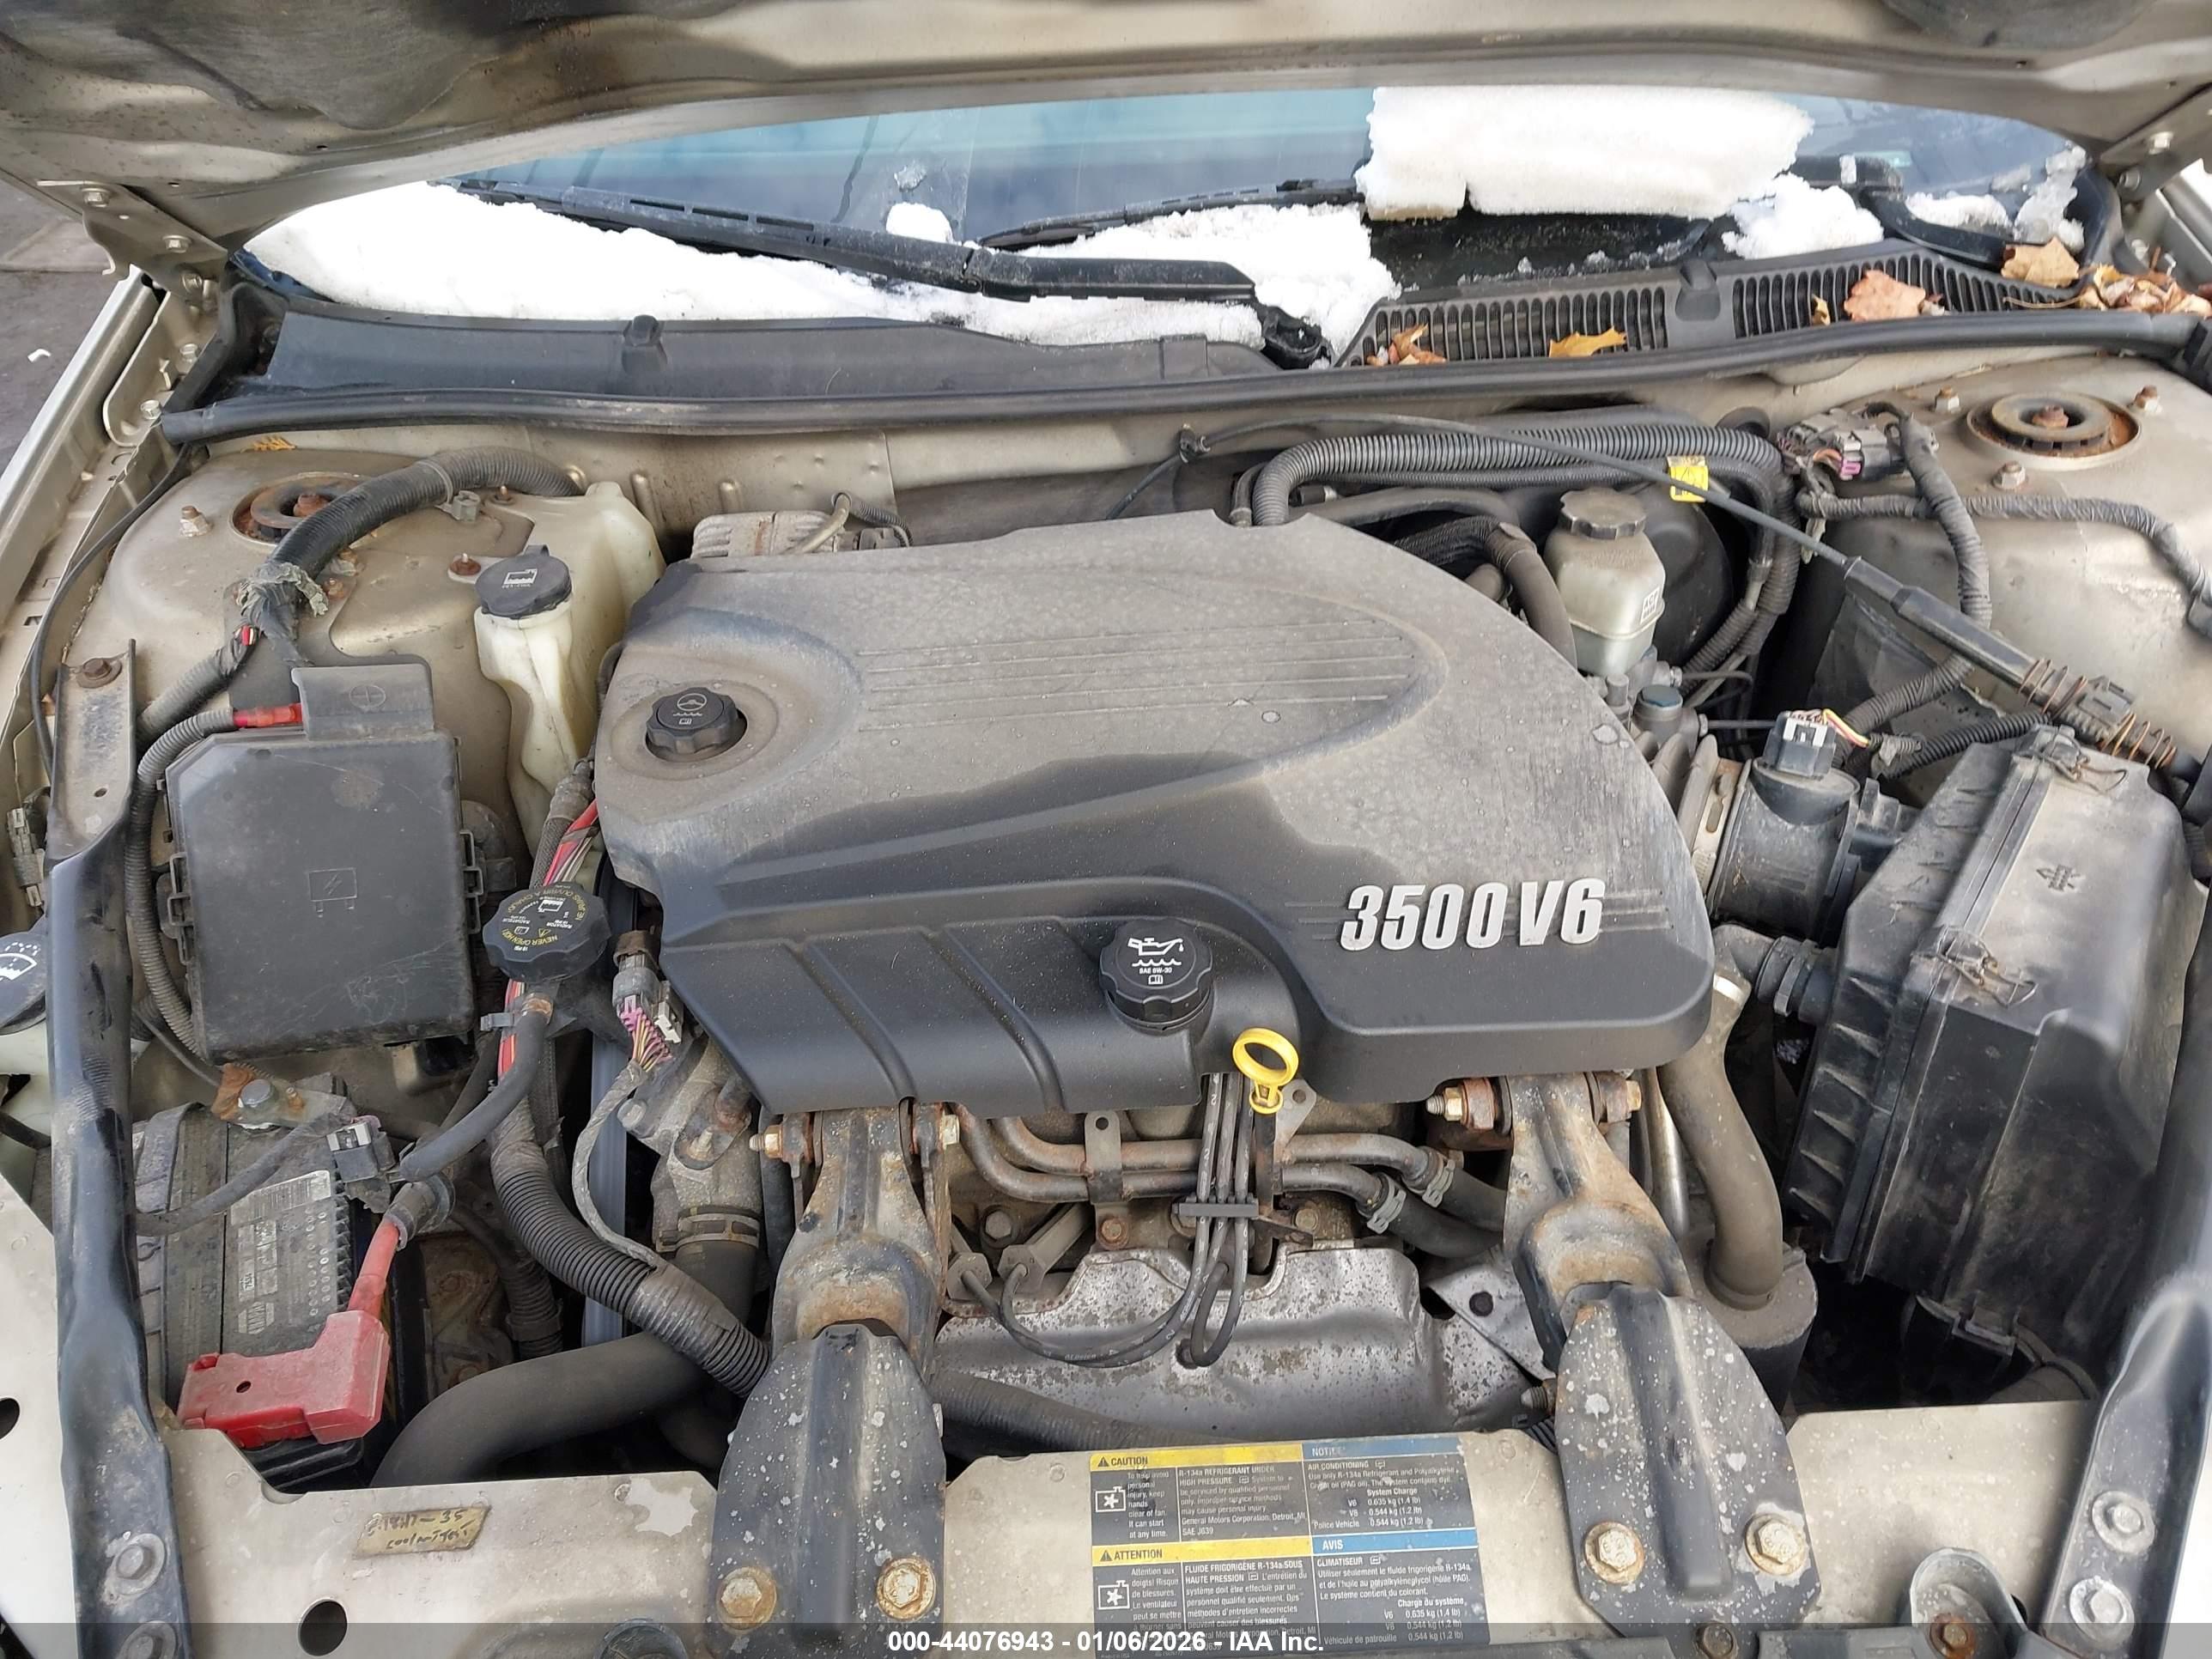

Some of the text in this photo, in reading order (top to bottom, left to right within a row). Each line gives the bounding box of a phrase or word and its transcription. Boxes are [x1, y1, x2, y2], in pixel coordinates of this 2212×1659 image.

[1340, 878, 1606, 951] 3500 V6
[513, 936, 531, 945] OPEN
[532, 935, 558, 946] NEVER
[1110, 1456, 1148, 1466] CAUTION
[1321, 1461, 1369, 1470] CONDITIONING
[1204, 1466, 1249, 1476] REFRIGERANT
[1251, 1465, 1274, 1474] UNDER
[1322, 1471, 1335, 1480] only
[1363, 1468, 1399, 1479] Refrigerant
[1180, 1478, 1195, 1486] HIGH
[1198, 1476, 1232, 1486] PRESSURE
[1341, 1480, 1356, 1489] (PAG
[1190, 1486, 1217, 1495] serviced
[1219, 1486, 1227, 1495] by
[1228, 1485, 1255, 1494] qualified
[1393, 1487, 1418, 1496] Charge
[1388, 1497, 1397, 1507] kg
[1218, 1505, 1246, 1515] personal
[1389, 1508, 1398, 1516] kg
[1399, 1507, 1412, 1516] (1.2
[1413, 1506, 1422, 1515] lb)
[1182, 1516, 1206, 1525] General
[1207, 1514, 1231, 1523] Motors
[1314, 1516, 1424, 1529] Police Vehicle 0.544 kg (1.2 lb)
[1151, 1529, 1168, 1538] time.
[1182, 1527, 1213, 1536] SAE J639
[1322, 1539, 1344, 1551] AVIS
[1114, 1548, 1163, 1560] ATTENTION
[1185, 1565, 1209, 1573] FLUIDE
[1257, 1559, 1283, 1570] R-134a
[1284, 1559, 1303, 1568] SOUS
[1316, 1556, 1363, 1567] CLIMATISEUR
[1131, 1567, 1161, 1576] Attention
[1185, 1569, 1308, 1584] HAUTE PRESSION L'entretien du
[1318, 1569, 1341, 1577] Utiliser
[1343, 1567, 1377, 1577] seulement
[1388, 1566, 1407, 1575] fluide
[1156, 1577, 1179, 1587] Risque
[1328, 1580, 1336, 1589] de
[1338, 1578, 1358, 1589] l'huile
[1432, 1575, 1451, 1585] (huile
[1132, 1589, 1141, 1598] de
[1215, 1584, 1229, 1594] doit
[1230, 1583, 1243, 1593] être
[1274, 1583, 1286, 1591] par
[1330, 1590, 1358, 1600] système
[1359, 1589, 1387, 1598] contient
[1389, 1588, 1398, 1596] du
[1399, 1587, 1428, 1596] colorant.
[1133, 1600, 1177, 1609] Le ventilateur
[1187, 1593, 1300, 1607] personnel qualifié seulement. Des
[1398, 1599, 1423, 1608] Charge
[1425, 1597, 1433, 1606] du
[1133, 1612, 1150, 1621] peut
[1159, 1611, 1182, 1620] mettre
[1187, 1604, 1298, 1618] méthodes d'entretien incorrectes
[1384, 1607, 1461, 1620] V6 kg lb)
[1188, 1620, 1215, 1629] peuvent
[1241, 1618, 1254, 1626] des
[1385, 1621, 1395, 1631] V8
[1427, 1620, 1437, 1630] kg
[1452, 1619, 1462, 1628] lb)
[1308, 1626, 1316, 1635] MI
[1324, 1635, 1353, 1645] Véhicule
[1355, 1635, 1364, 1644] de
[1365, 1633, 1397, 1644] patrouille
[1429, 1632, 1438, 1641] kg
[1454, 1630, 1464, 1640] lb)
